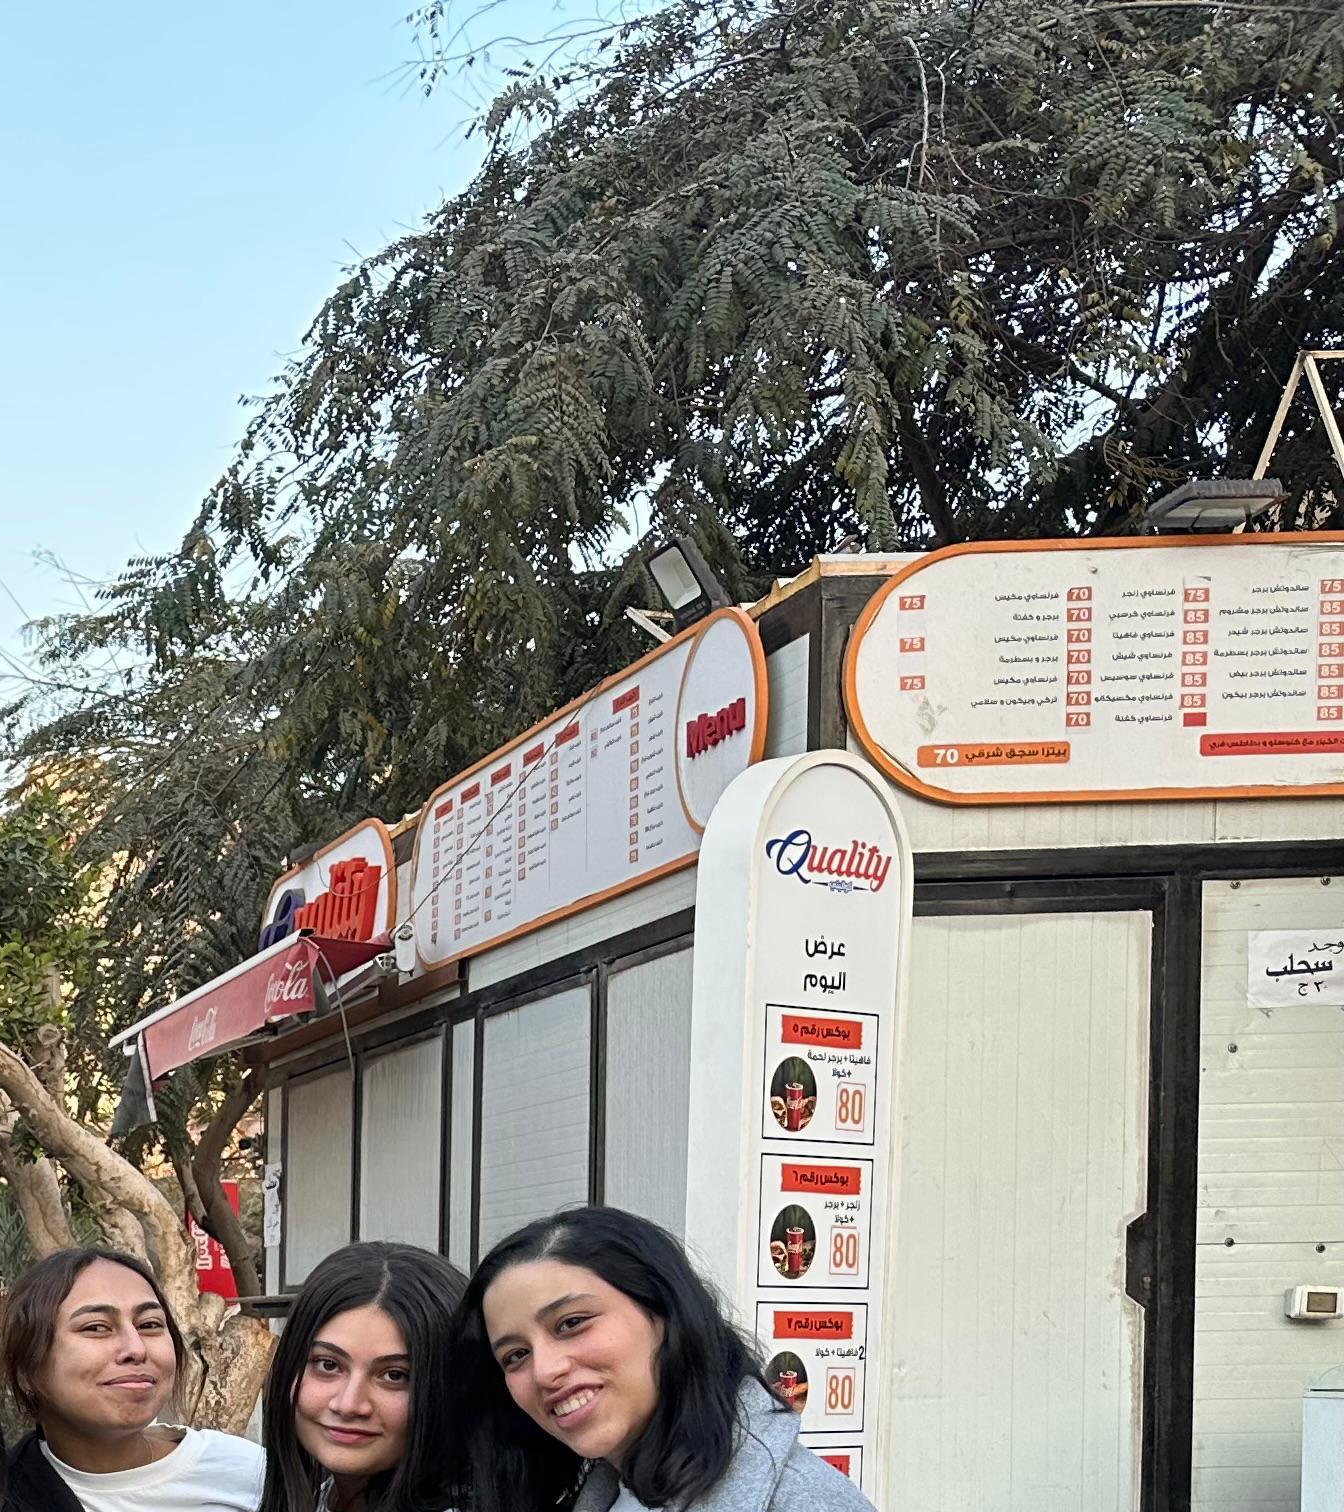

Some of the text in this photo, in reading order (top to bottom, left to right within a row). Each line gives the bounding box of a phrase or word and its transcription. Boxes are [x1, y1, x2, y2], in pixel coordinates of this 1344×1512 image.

[1324, 581, 1341, 592] 75
[1071, 588, 1089, 600] 70
[1187, 590, 1205, 601] 75
[903, 598, 922, 609] 75
[1322, 602, 1340, 613] 85
[1070, 609, 1089, 621] 70
[1186, 611, 1205, 622] 85
[1321, 623, 1339, 634] 85
[1070, 630, 1089, 642] 70
[1185, 632, 1204, 643] 85
[903, 638, 922, 650] 75
[1321, 644, 1339, 655] 85
[1070, 651, 1089, 663] 70
[1185, 653, 1203, 664] 85
[1320, 665, 1338, 676] 85
[1069, 672, 1088, 684] 70
[1184, 674, 1203, 686] 85
[903, 679, 922, 690] 75
[1320, 686, 1338, 698] 85
[1069, 693, 1088, 705] 70
[1069, 714, 1088, 725] 70
[1320, 708, 1338, 719] 85
[686, 697, 746, 759] Menu
[933, 748, 959, 764] 70
[765, 829, 893, 893] Quality
[805, 934, 847, 960] عرض
[1307, 940, 1344, 955] وجد
[1265, 952, 1334, 983] سحلب
[803, 971, 847, 995] اليوم
[838, 1088, 863, 1125] 80
[832, 1232, 857, 1268] 80
[828, 1374, 854, 1410] 80
